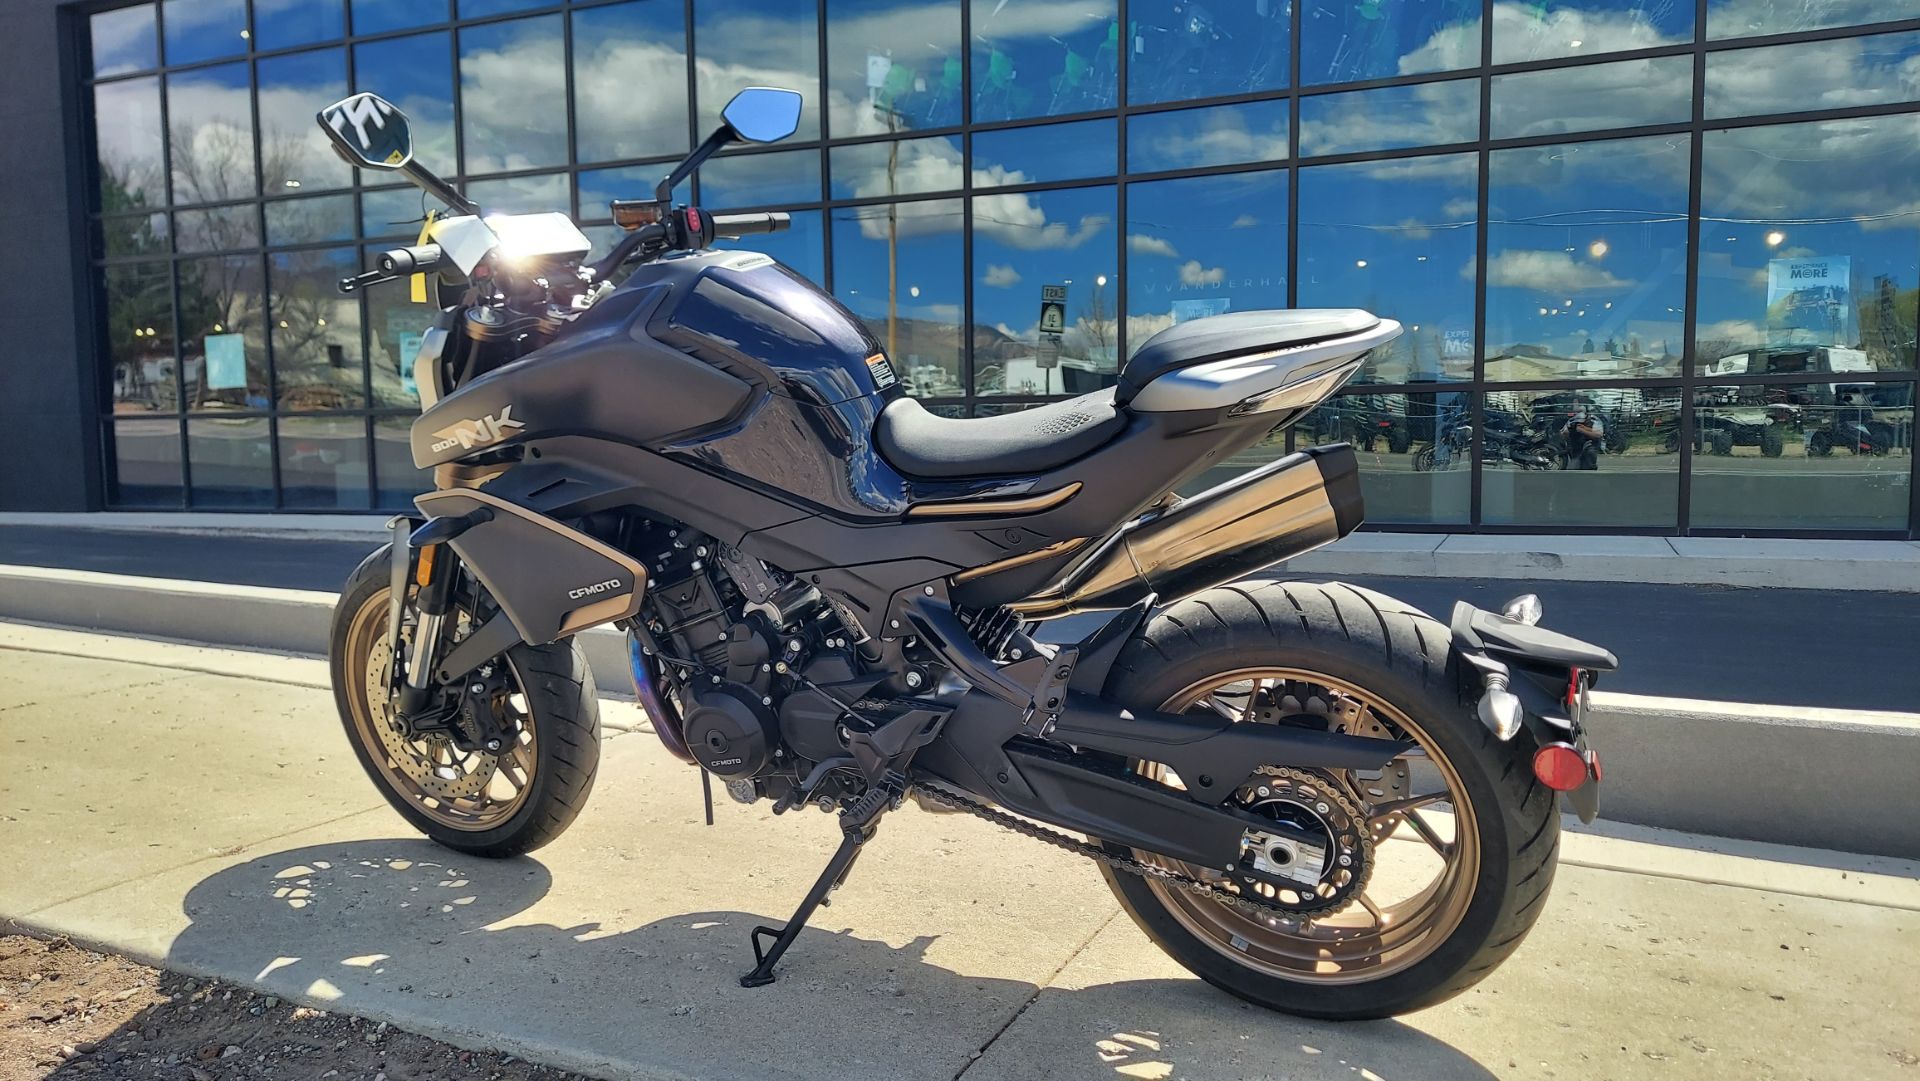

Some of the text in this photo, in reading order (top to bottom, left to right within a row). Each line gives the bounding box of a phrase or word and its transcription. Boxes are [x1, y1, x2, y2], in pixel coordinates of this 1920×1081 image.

[1165, 276, 1320, 292] VANDERHAL
[568, 579, 621, 599] CFMOTO
[711, 758, 742, 767] CFMOTO
